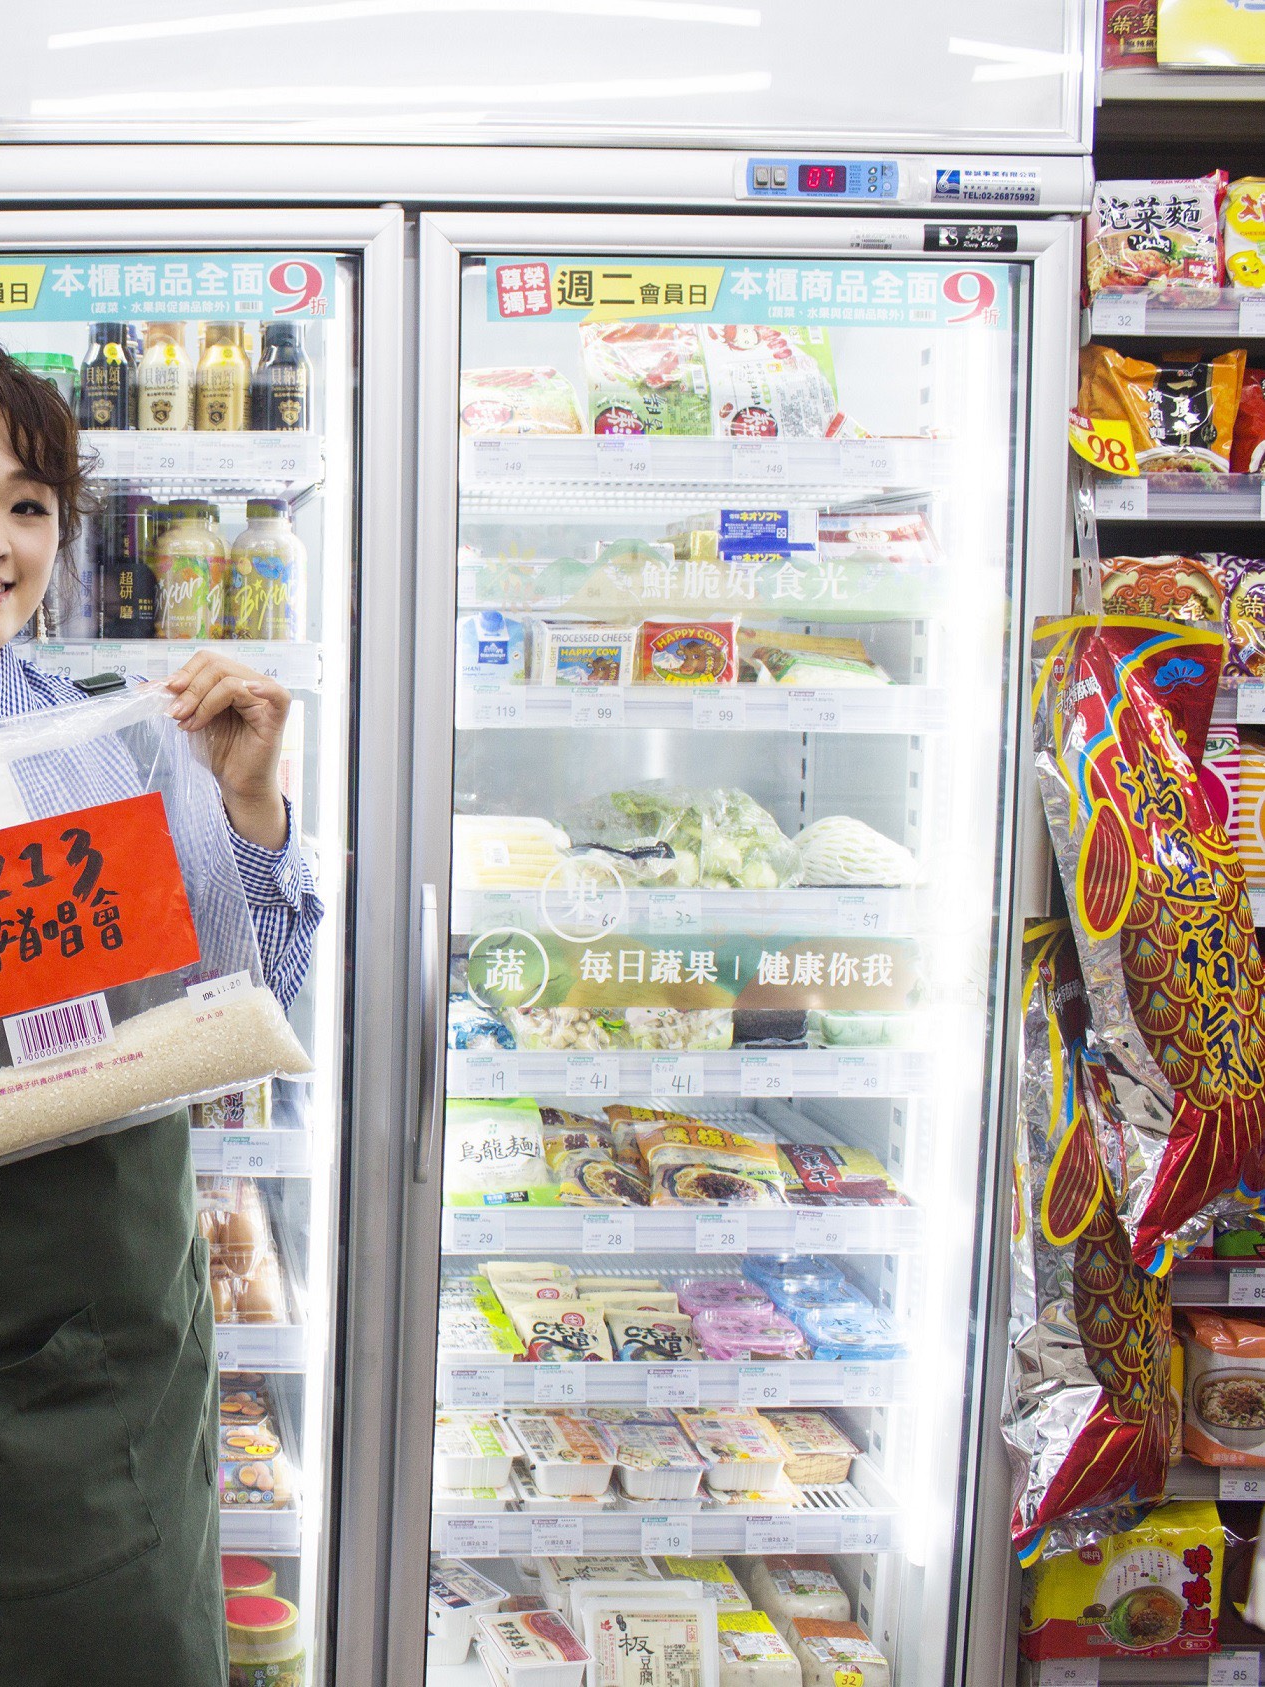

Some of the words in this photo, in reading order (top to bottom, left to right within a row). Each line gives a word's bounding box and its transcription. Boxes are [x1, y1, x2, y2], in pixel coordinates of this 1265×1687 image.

[808, 168, 834, 189] 07
[963, 192, 1035, 202] TEL:02-26875992
[1099, 194, 1202, 233] 泡菜麵
[52, 260, 264, 297] 本櫃商品全面
[730, 268, 938, 305] 本櫃商品全面
[1118, 315, 1131, 326] 32
[1088, 435, 1130, 470] 98
[160, 457, 175, 468] 29
[219, 458, 234, 469] 29
[281, 459, 295, 470] 29
[505, 462, 521, 471] 149
[767, 465, 783, 473] 149
[1120, 500, 1134, 511] 45
[740, 512, 781, 522] ネオソフト
[641, 560, 849, 600] 鮮脆好食光
[119, 571, 133, 620] 超研磨
[551, 633, 595, 644] PROCESSED
[597, 632, 632, 643] CHEESE
[656, 628, 695, 649] HAPPY
[697, 627, 724, 648] COW
[496, 706, 516, 717] 119
[597, 708, 612, 719] 99
[719, 710, 733, 721] 99
[563, 880, 608, 921] 果
[484, 950, 524, 991] 蔬
[579, 950, 717, 985] 每日蔬果
[757, 950, 893, 987] 健康你我
[766, 1077, 780, 1088] 25
[863, 1077, 877, 1087] 49
[248, 1156, 263, 1167] 80
[479, 1233, 493, 1243] 29
[608, 1234, 622, 1245] 28
[721, 1234, 735, 1245] 28
[561, 1384, 574, 1395] 15
[763, 1387, 777, 1398] 62
[1244, 1481, 1258, 1492] 82
[667, 1537, 680, 1547] 19
[1178, 1544, 1214, 1636] 味味麵
[842, 1675, 856, 1686] 32
[1233, 1670, 1247, 1680] 85
